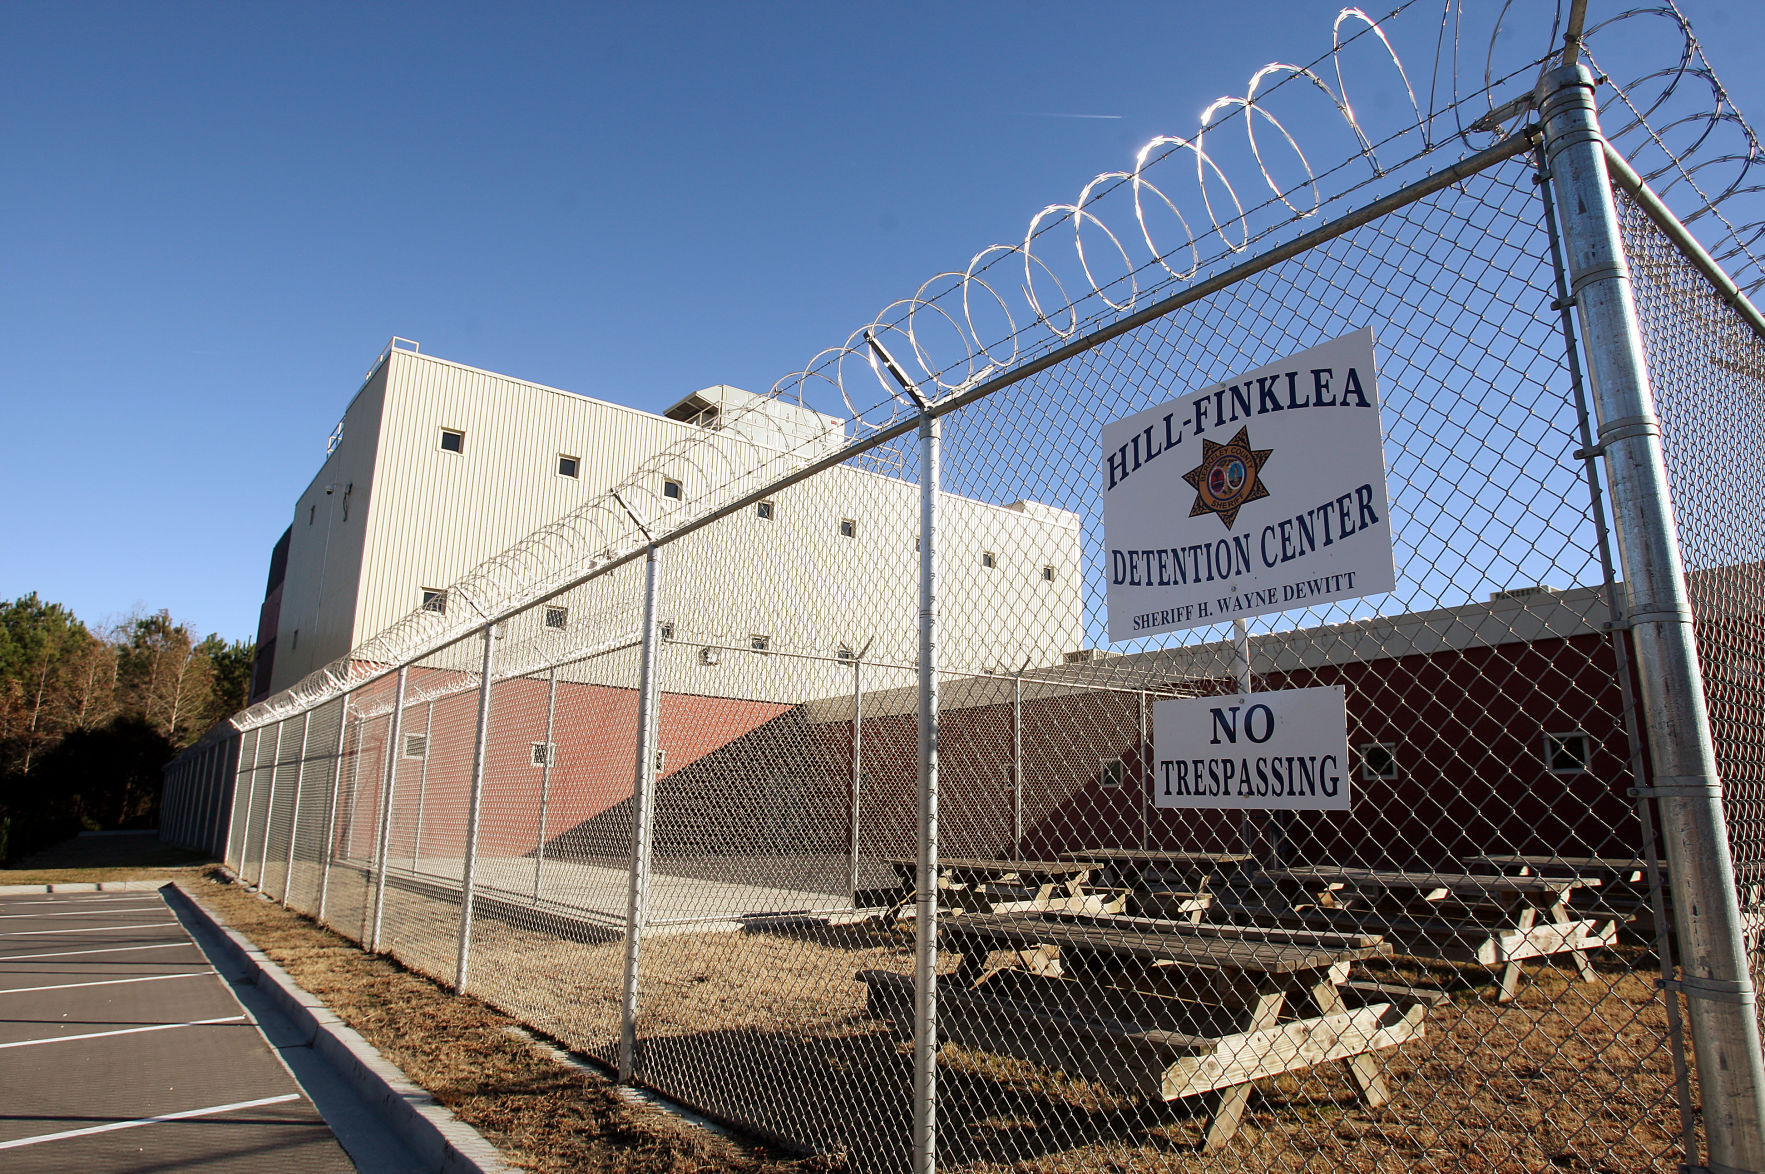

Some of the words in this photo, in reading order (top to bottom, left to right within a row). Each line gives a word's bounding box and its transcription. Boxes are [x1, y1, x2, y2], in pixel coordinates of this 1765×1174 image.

[1107, 367, 1371, 492] HILL-FINKLEA
[1200, 448, 1228, 482] BERKELEY
[1230, 447, 1255, 469] COUNTY
[1211, 493, 1244, 509] SHERIFF
[1112, 533, 1251, 587] DETENTION
[1260, 483, 1379, 569] CENTER
[1133, 605, 1194, 631] SHERIFF
[1198, 601, 1213, 618] H.
[1217, 588, 1278, 614] WAYNE
[1283, 571, 1356, 602] DEWITT
[1210, 703, 1275, 745] NO
[1160, 754, 1340, 798] TRESPASSING
